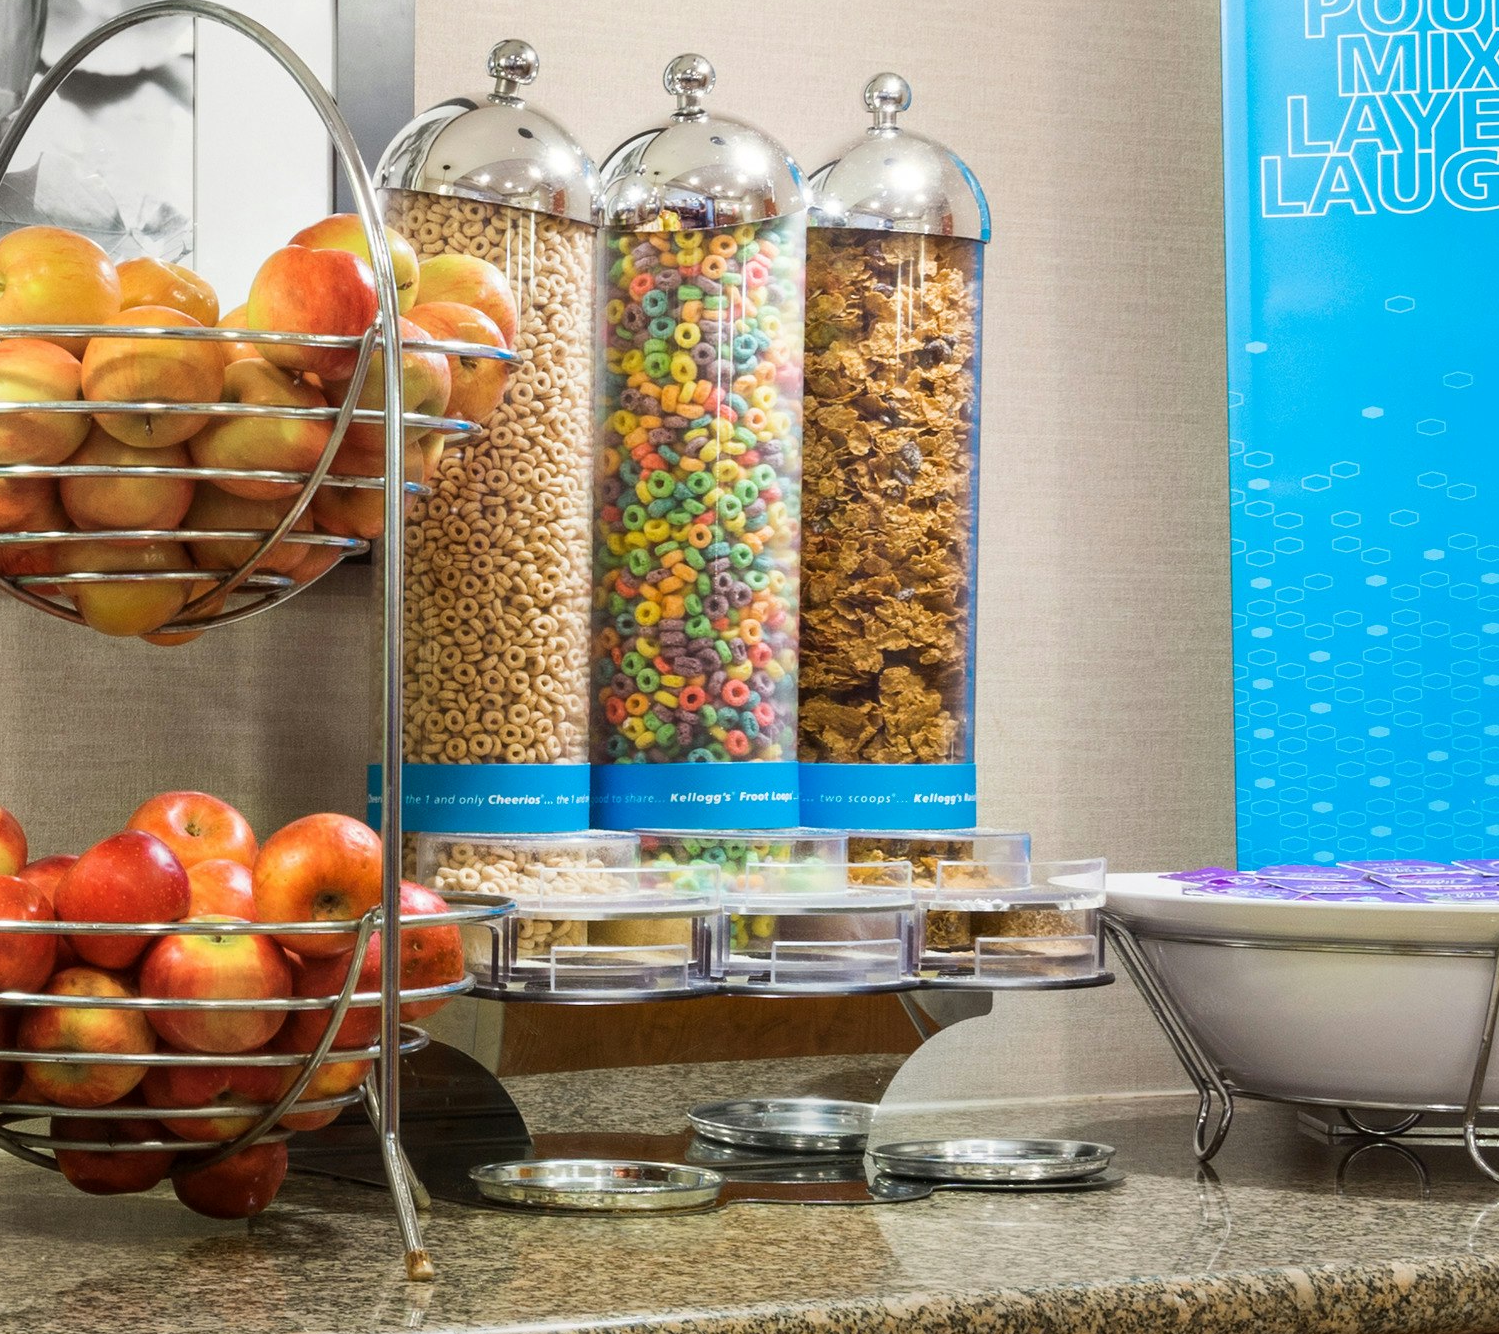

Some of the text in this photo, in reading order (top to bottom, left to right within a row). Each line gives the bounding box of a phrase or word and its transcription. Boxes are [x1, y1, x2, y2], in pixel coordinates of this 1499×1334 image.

[405, 794, 421, 804] the
[433, 794, 455, 805] and
[459, 794, 485, 807] only
[819, 793, 843, 803] two
